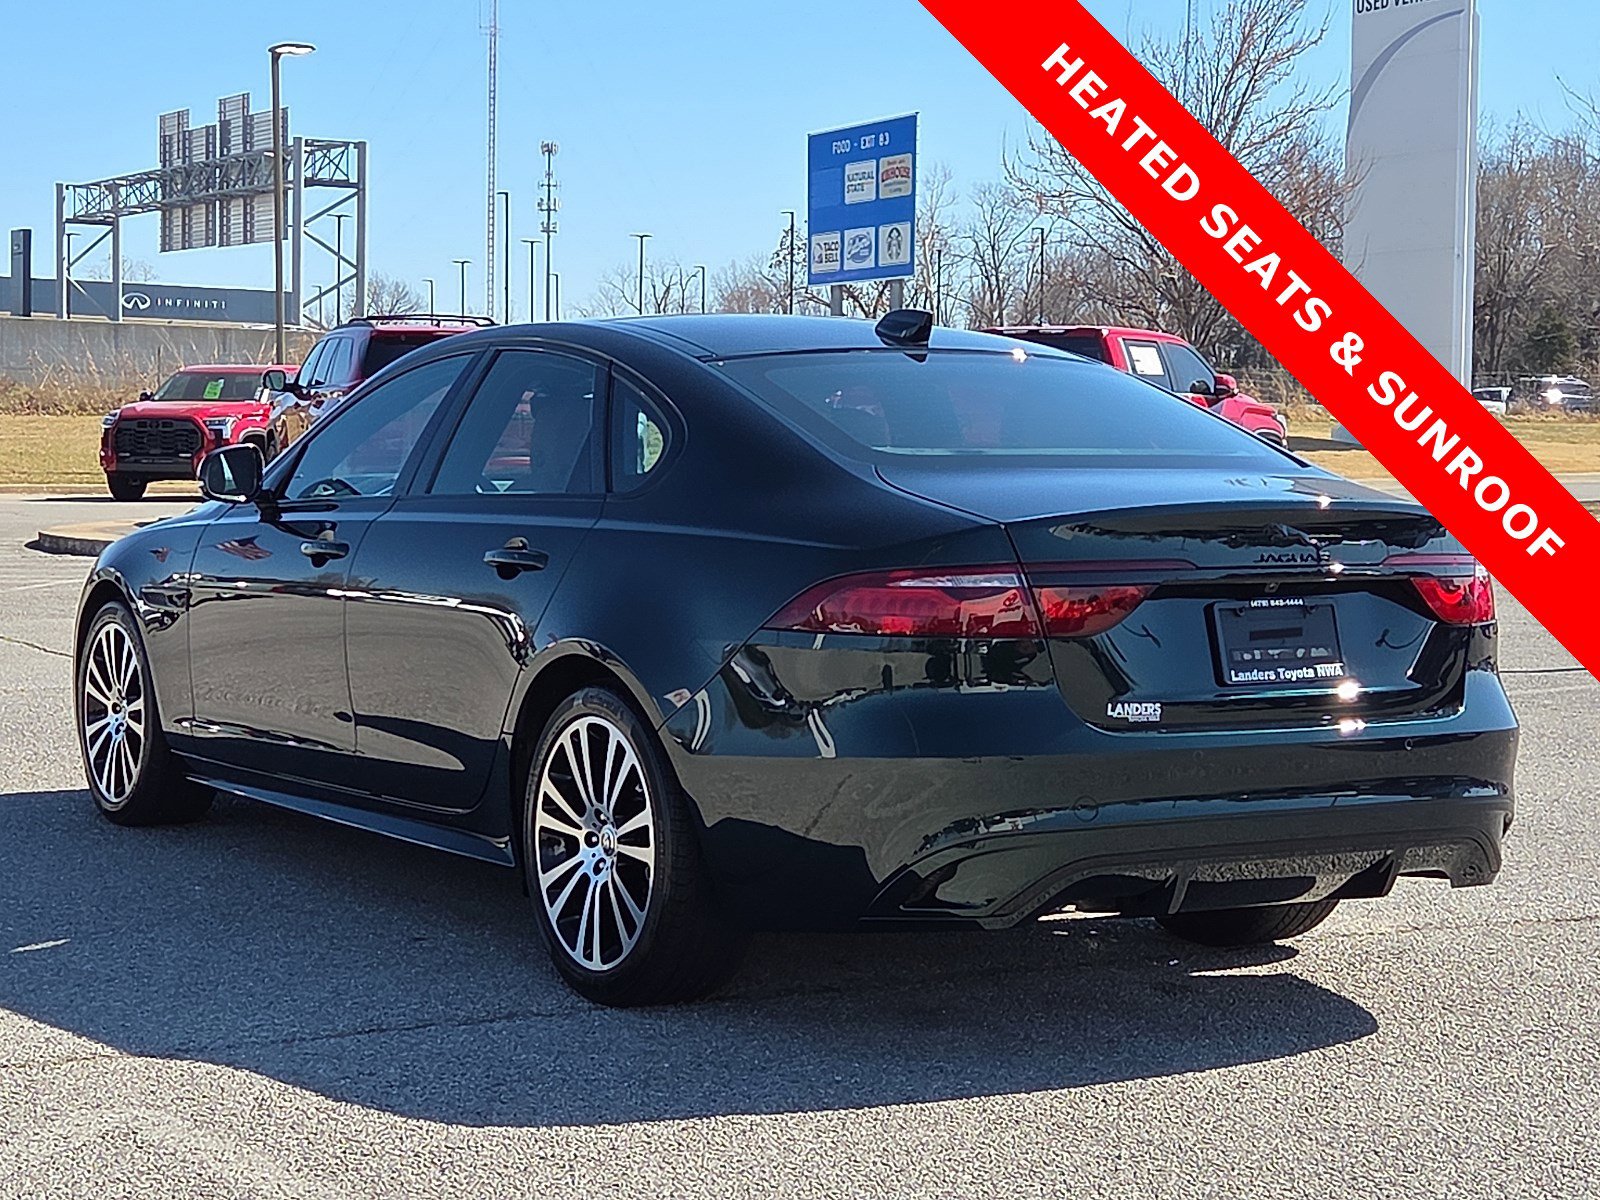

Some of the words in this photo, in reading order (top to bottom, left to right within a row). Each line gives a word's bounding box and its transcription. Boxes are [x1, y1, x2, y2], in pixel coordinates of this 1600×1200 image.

[832, 139, 851, 154] FOOD
[860, 134, 876, 150] EXIT
[846, 171, 875, 183] NATURAL
[846, 183, 865, 194] STATE
[156, 297, 227, 310] INFINITI
[1230, 667, 1276, 682] Landers
[1277, 667, 1315, 682] Toyota
[1315, 665, 1344, 677] NWA
[1107, 702, 1161, 717] LANDERS
